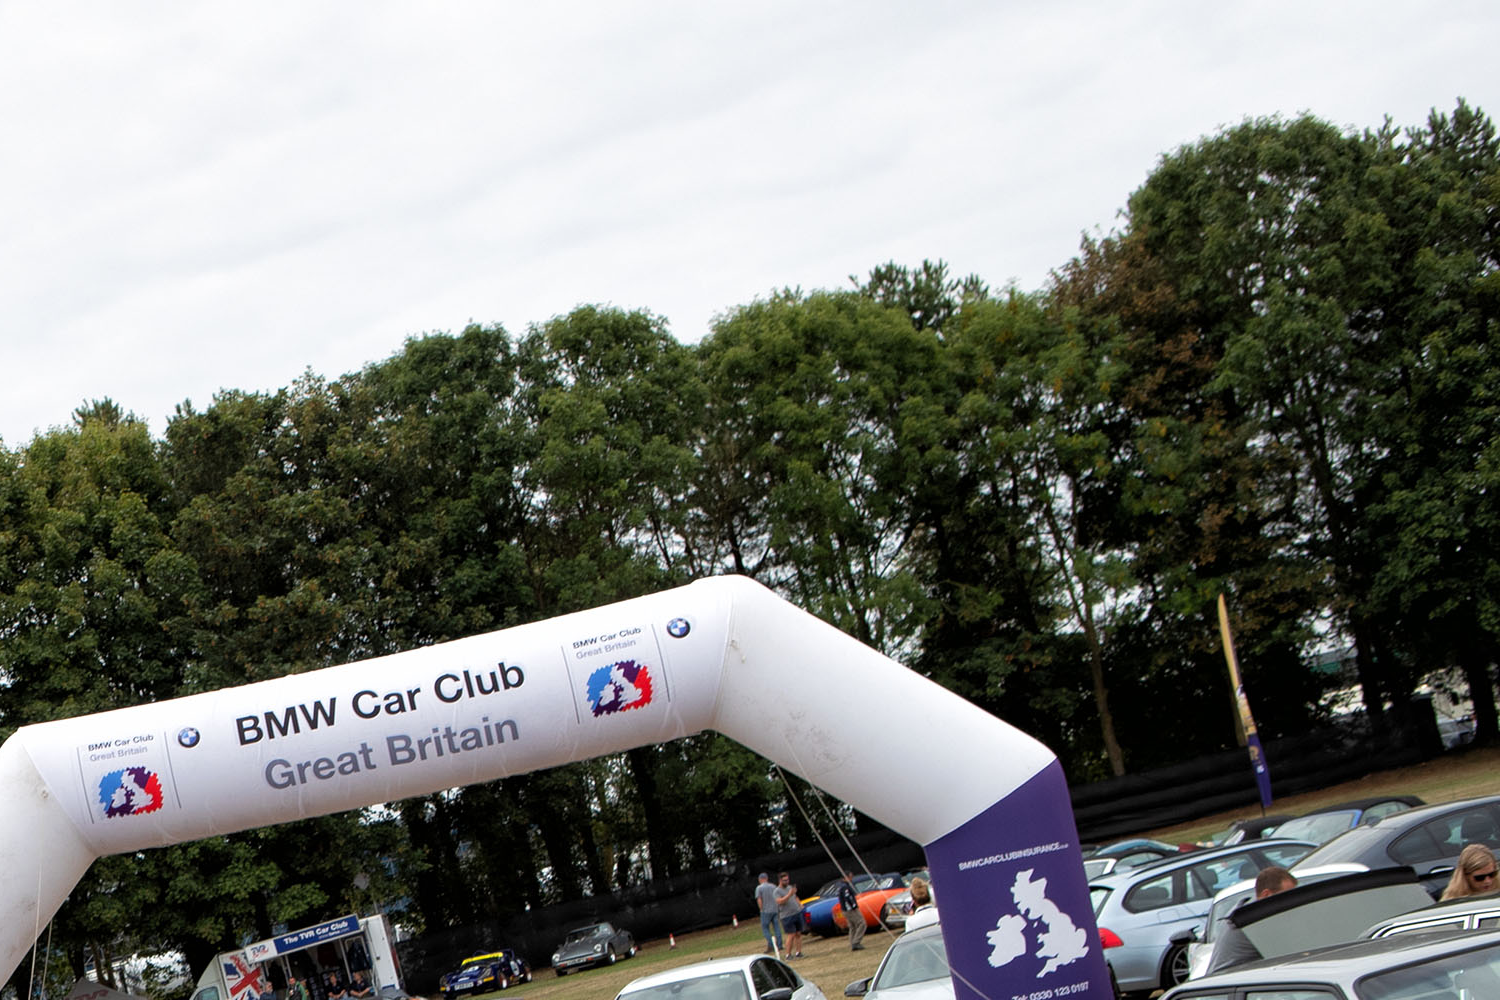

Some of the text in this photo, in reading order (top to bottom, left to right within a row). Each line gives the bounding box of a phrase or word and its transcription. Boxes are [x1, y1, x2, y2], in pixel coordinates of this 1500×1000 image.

[573, 627, 641, 649] BMW Car Club
[576, 640, 637, 660] Great Britain
[236, 661, 525, 745] BMW Car Club
[88, 734, 154, 752] BMW Car Club
[89, 745, 148, 762] Great Britain
[265, 716, 519, 790] Great Britain
[959, 842, 1069, 871] BMWCARCLUBINSURANCE
[283, 936, 299, 945] The
[299, 930, 315, 940] TVR
[316, 926, 329, 935] Car
[331, 920, 348, 931] Club
[1054, 985, 1070, 997] 123
[1070, 981, 1089, 993] 0197
